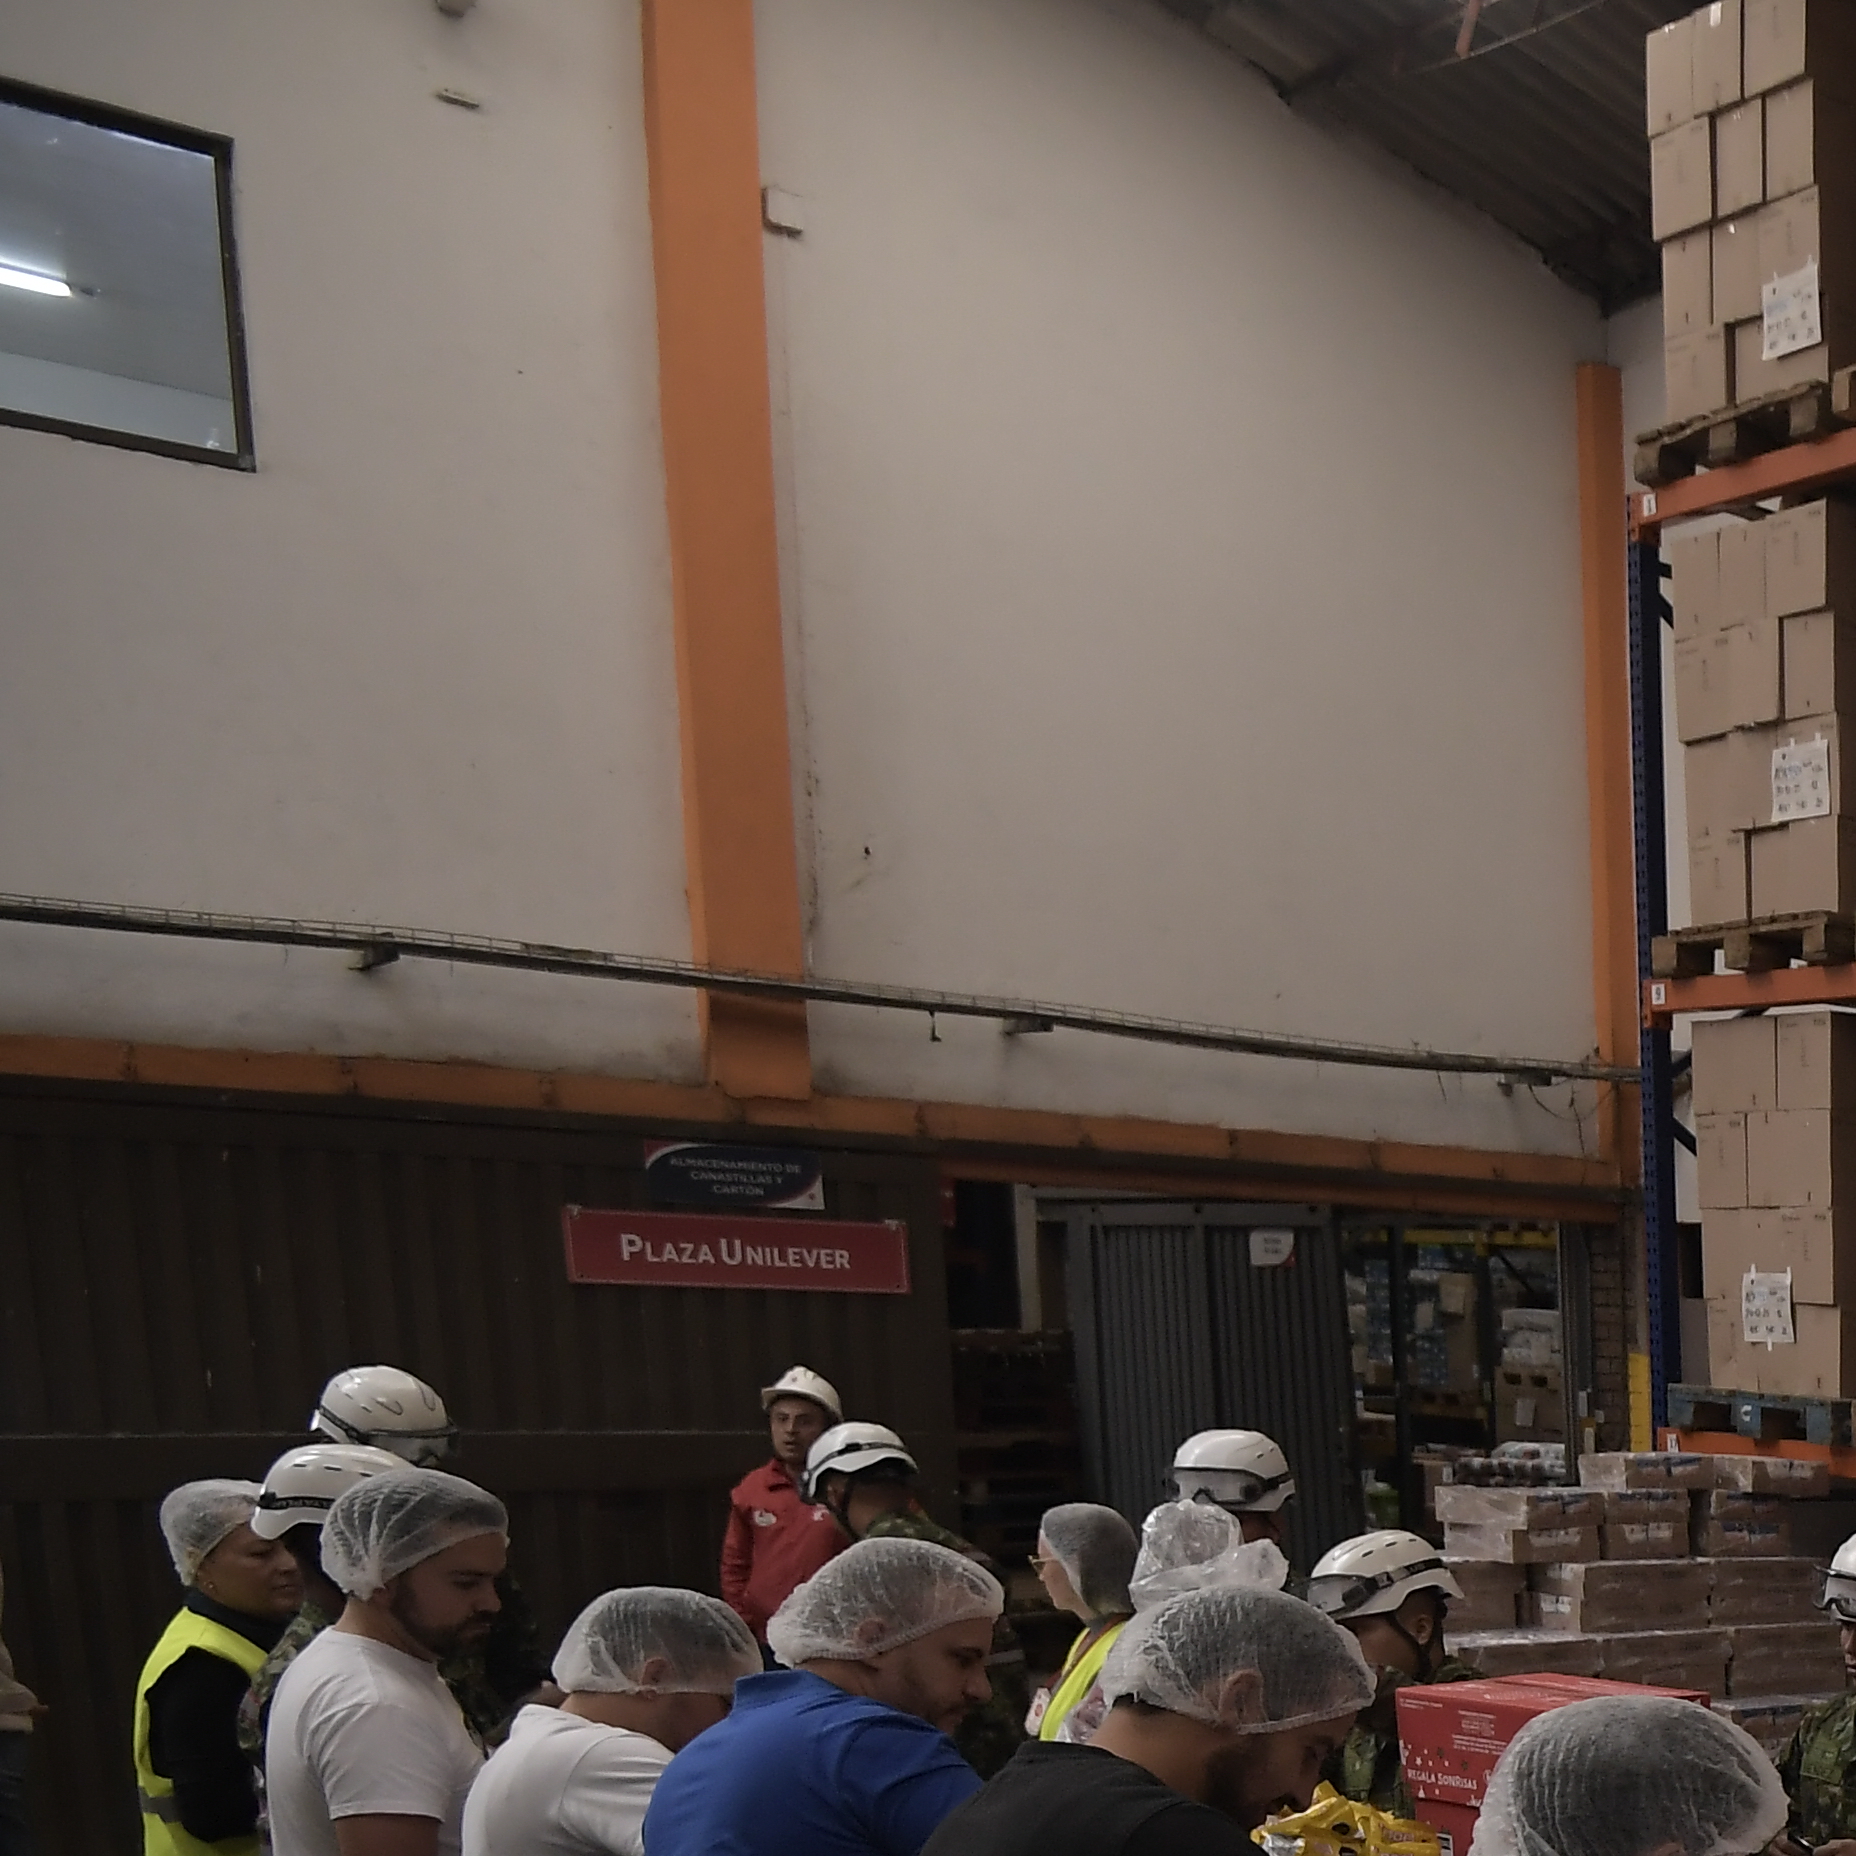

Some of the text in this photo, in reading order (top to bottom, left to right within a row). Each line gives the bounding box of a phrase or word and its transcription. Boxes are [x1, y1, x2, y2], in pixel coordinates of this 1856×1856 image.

[1654, 986, 1663, 1003] 9
[1407, 1769, 1477, 1790] REGALA SONRISAS
